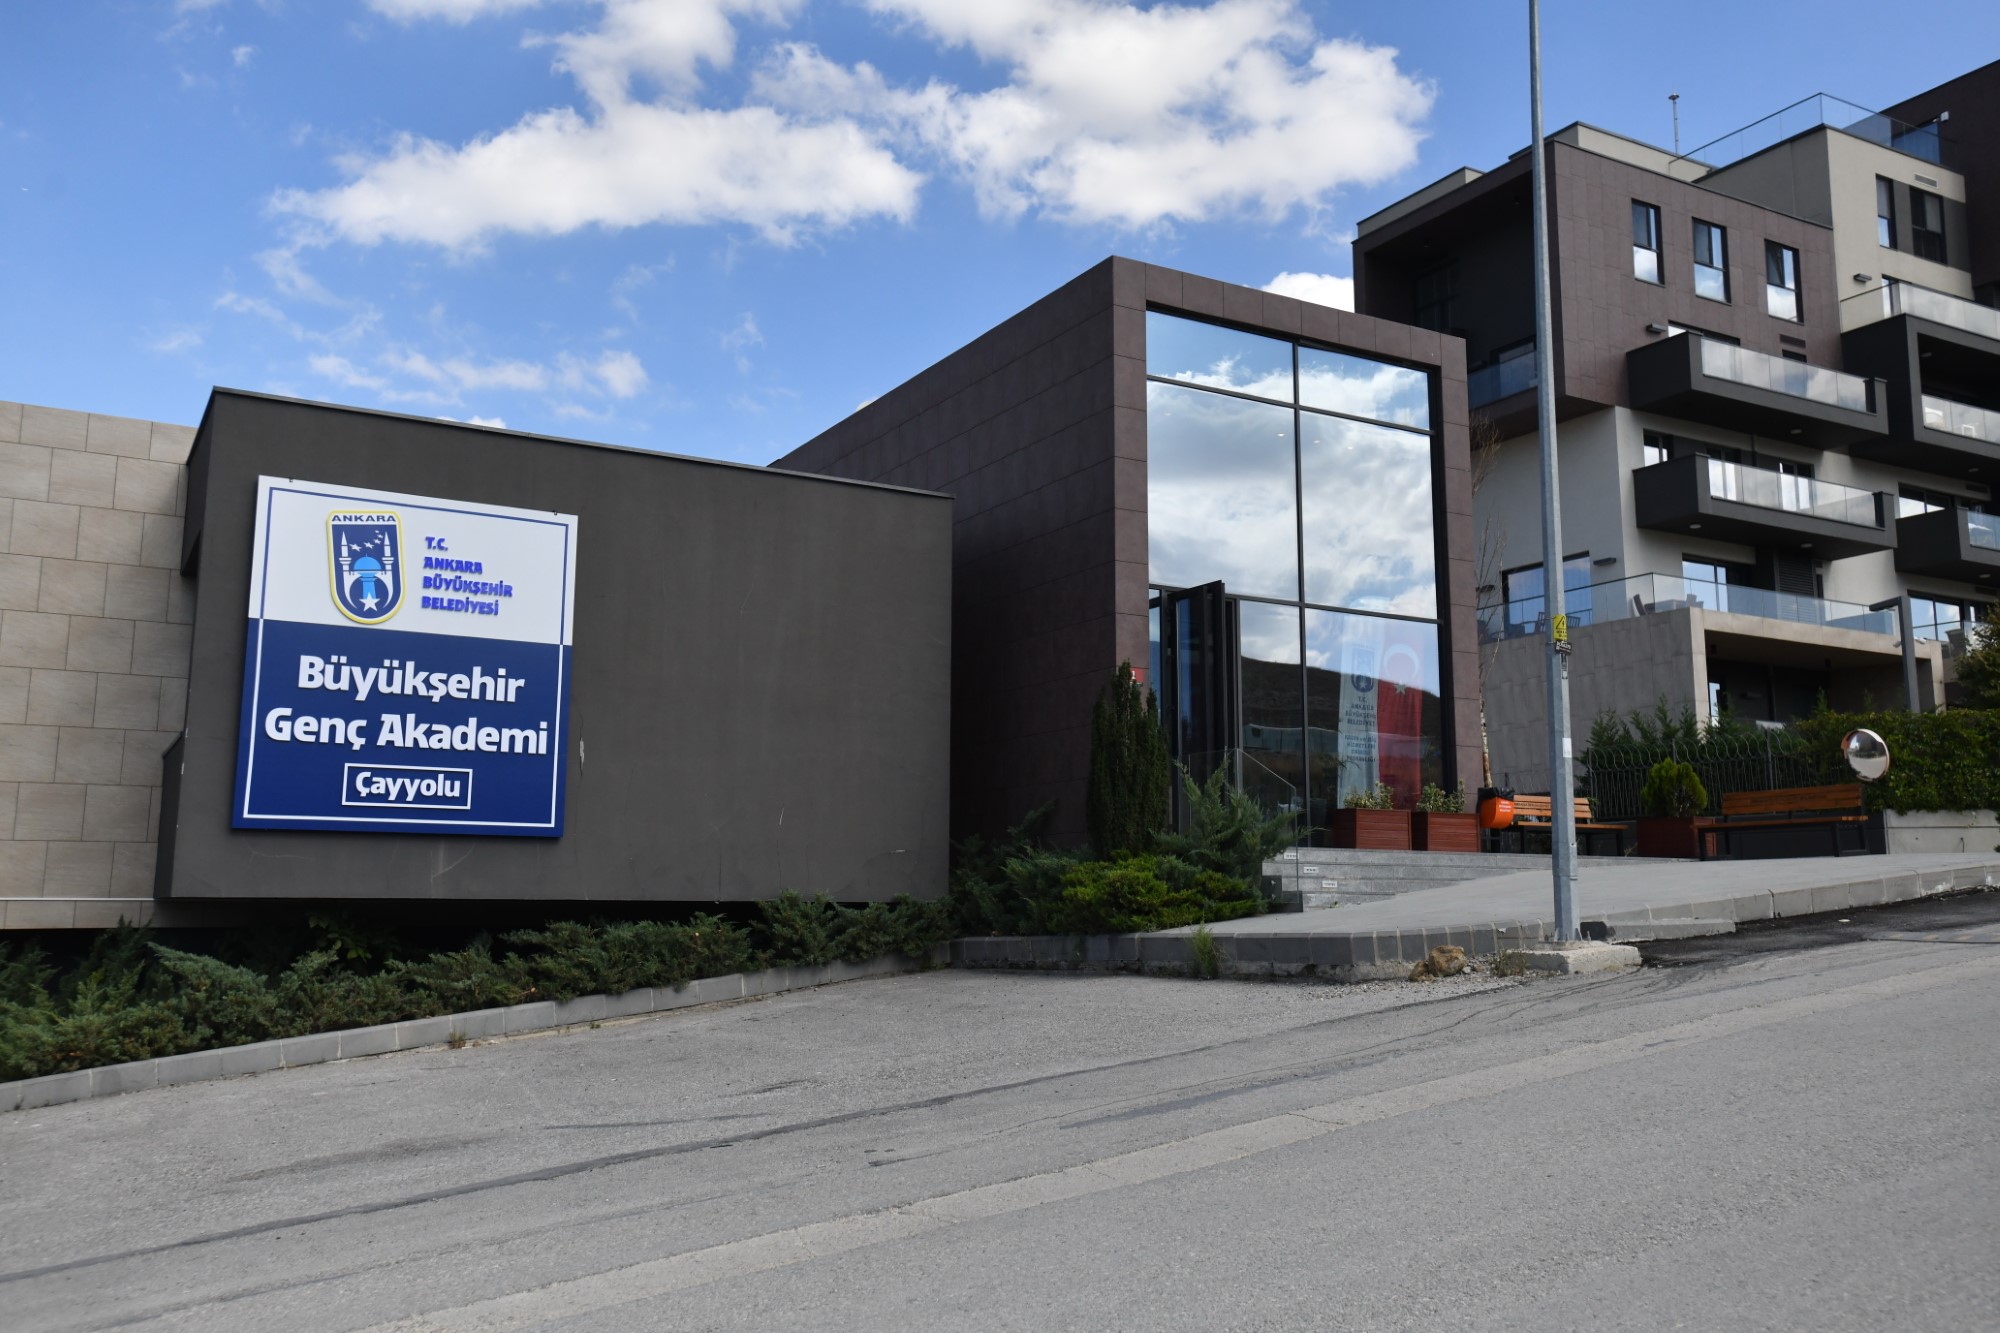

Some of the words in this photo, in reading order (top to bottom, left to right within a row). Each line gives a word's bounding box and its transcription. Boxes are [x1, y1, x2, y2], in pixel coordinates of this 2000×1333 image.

[332, 514, 396, 522] ANKARA
[425, 536, 449, 551] T.C.
[423, 556, 483, 575] ANKARA
[422, 573, 513, 598] BÜYÜKŞEHİR
[421, 596, 499, 616] BELEDİYESİ
[298, 655, 526, 702] Büyükşehir
[265, 707, 367, 750] Genç
[376, 713, 548, 755] Akademi
[355, 771, 461, 801] Çayyolu
